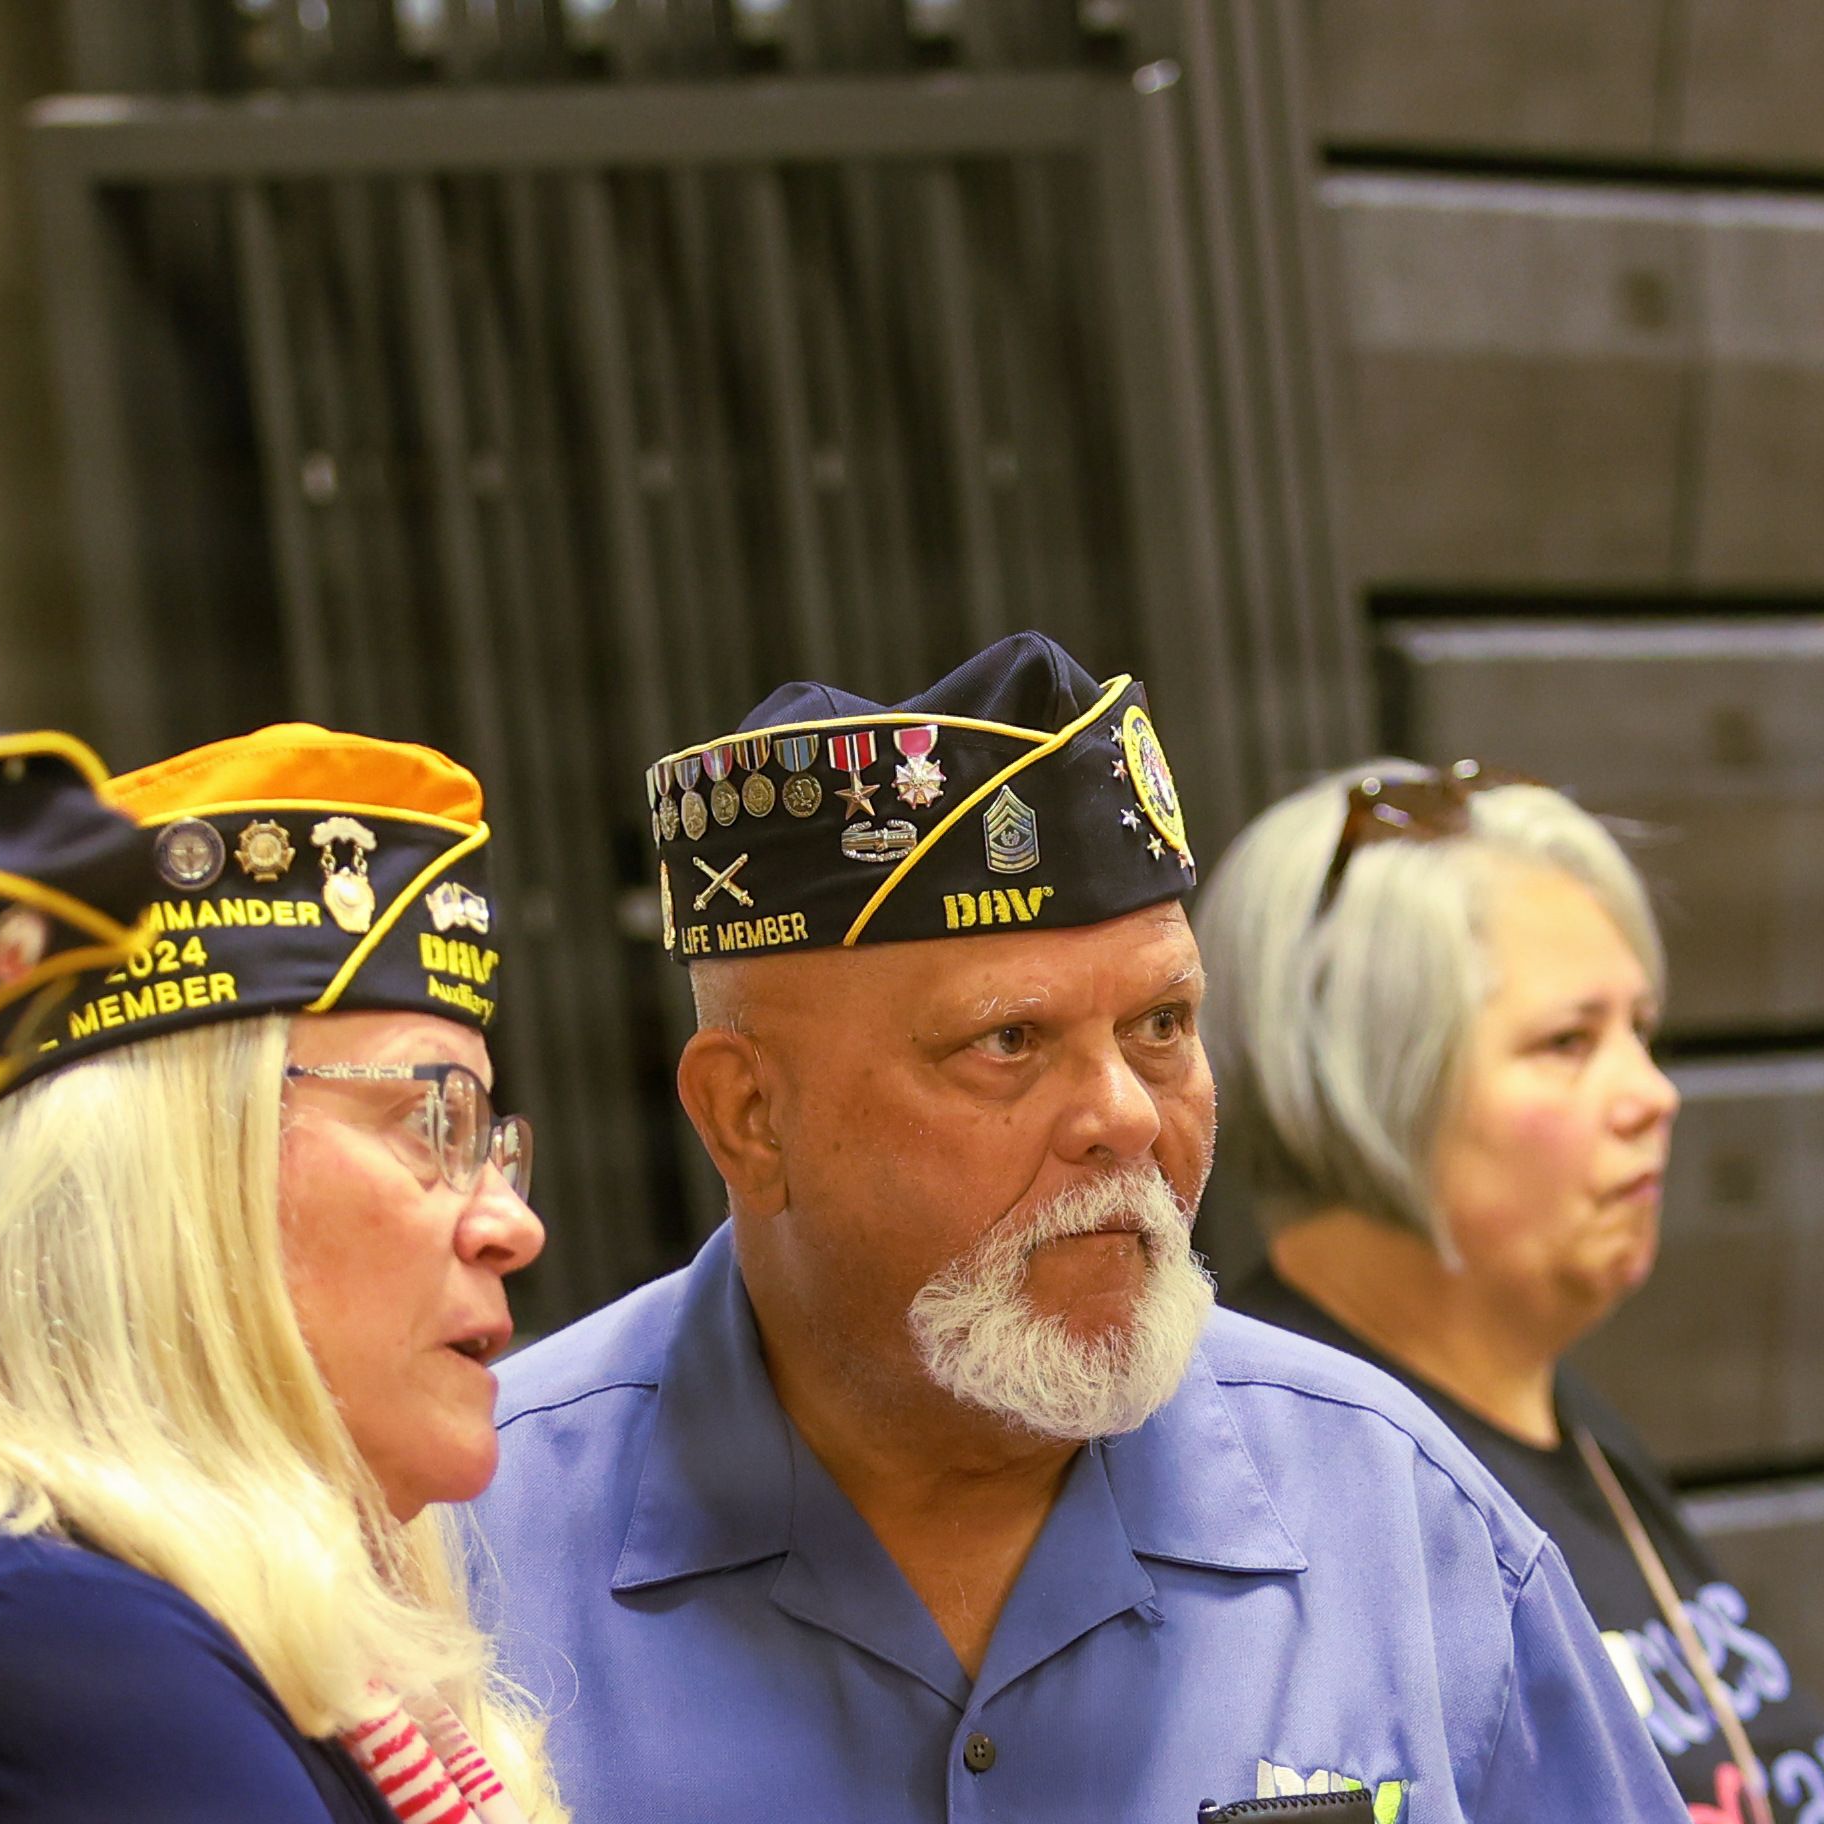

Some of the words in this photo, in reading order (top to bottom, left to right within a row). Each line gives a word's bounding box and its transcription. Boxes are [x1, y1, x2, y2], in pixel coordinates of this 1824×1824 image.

[419, 932, 500, 985] DAV
[680, 924, 712, 955] LIFE
[716, 911, 809, 952] MEMBER
[68, 971, 239, 1042] MEMBER
[428, 974, 495, 1027] Auxiliary
